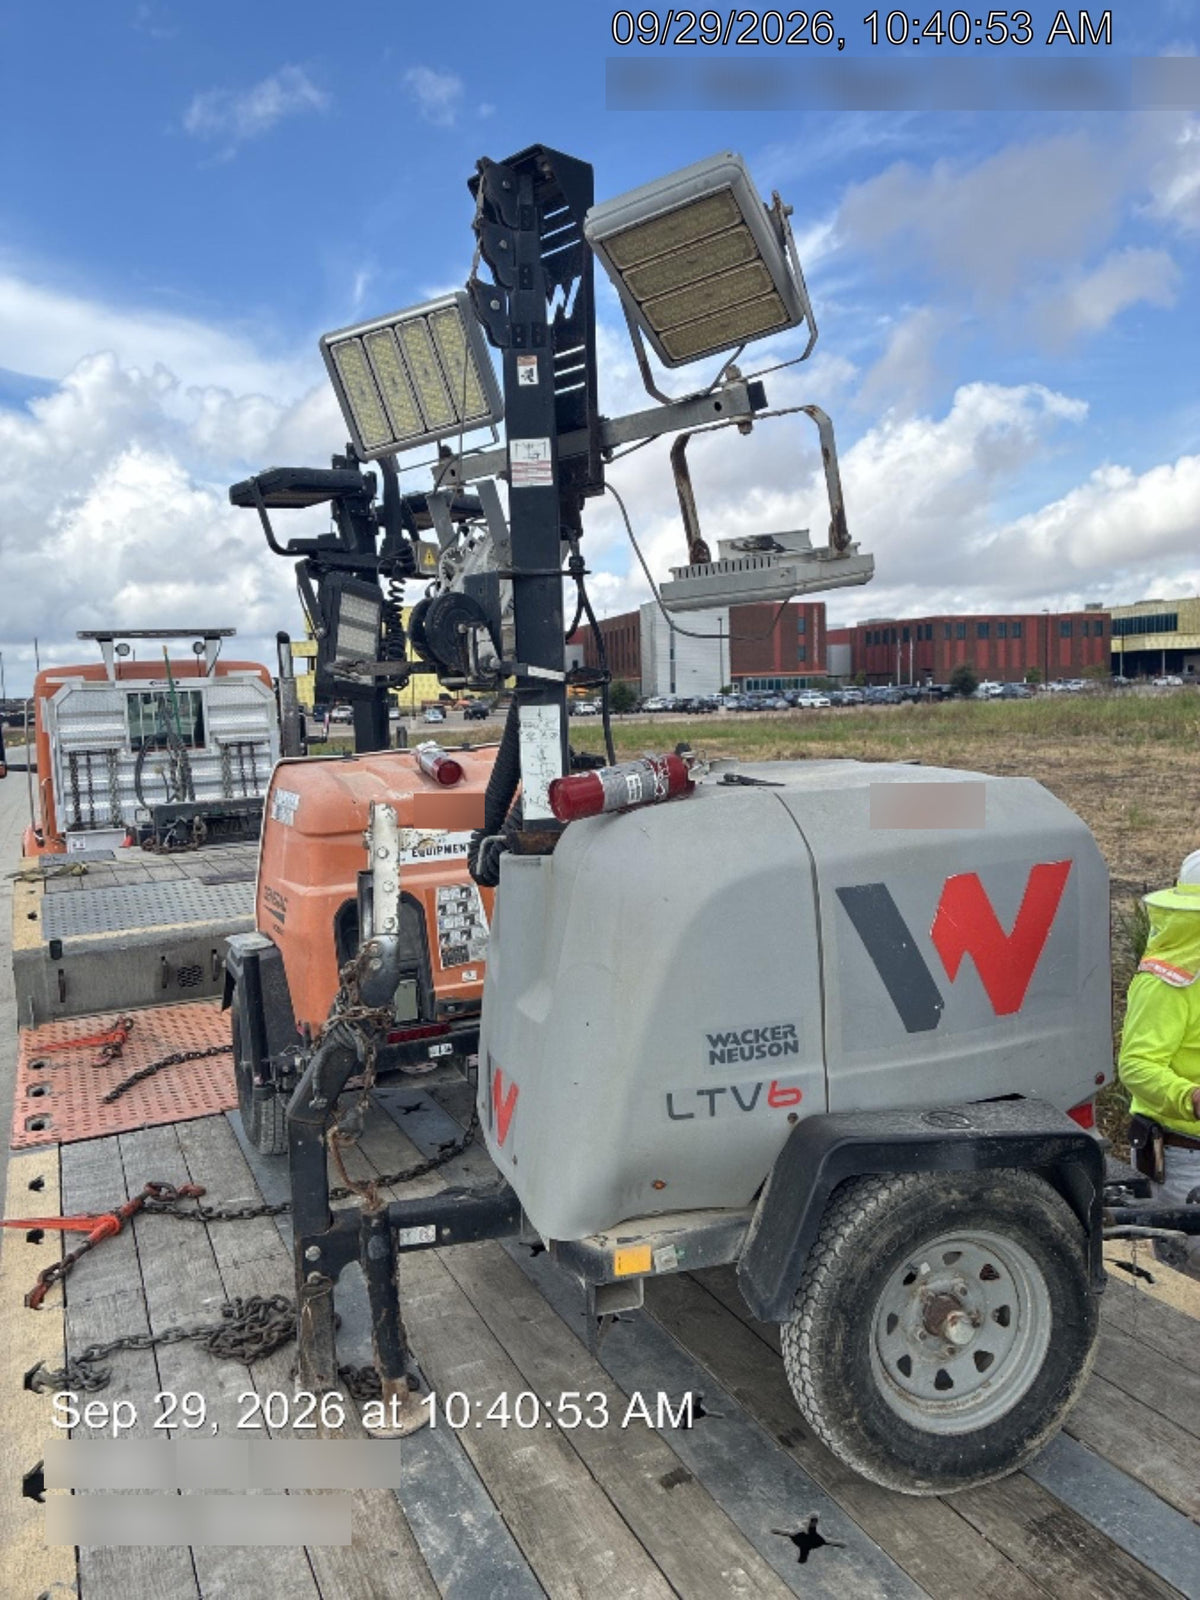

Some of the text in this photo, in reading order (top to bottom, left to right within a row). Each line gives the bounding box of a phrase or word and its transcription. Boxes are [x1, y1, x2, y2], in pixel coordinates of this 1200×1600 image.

[412, 844, 468, 858] EQUIPMEN
[705, 1023, 798, 1049] WACKER
[708, 1039, 799, 1066] NEUSON
[666, 1080, 803, 1121] LTV6
